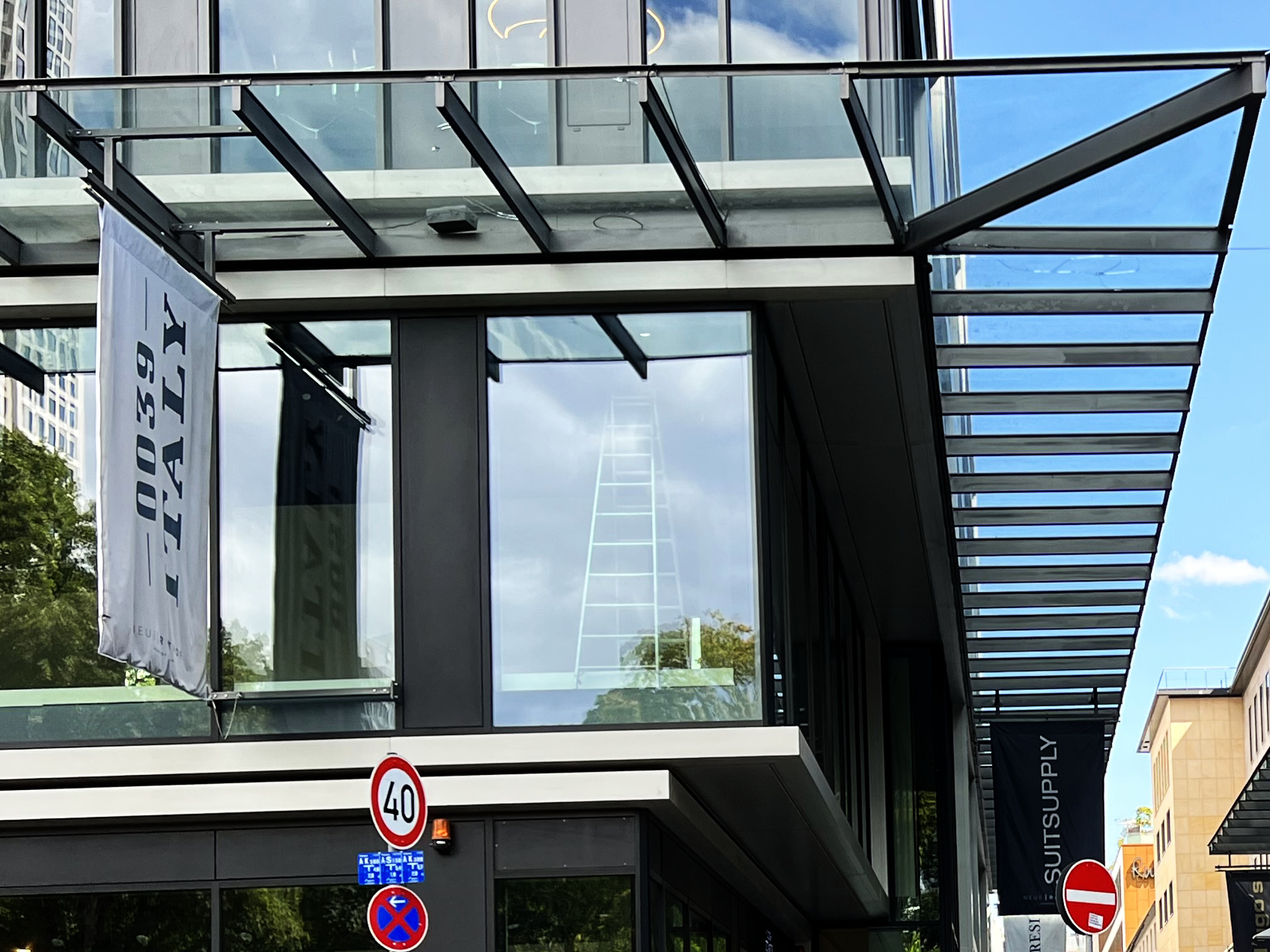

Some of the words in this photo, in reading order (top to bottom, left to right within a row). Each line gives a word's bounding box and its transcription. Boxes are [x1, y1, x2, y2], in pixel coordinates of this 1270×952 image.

[135, 340, 157, 522] 0039
[162, 292, 187, 608] ITALY
[383, 781, 415, 824] 40
[1039, 735, 1061, 885] SUITSUPPLY
